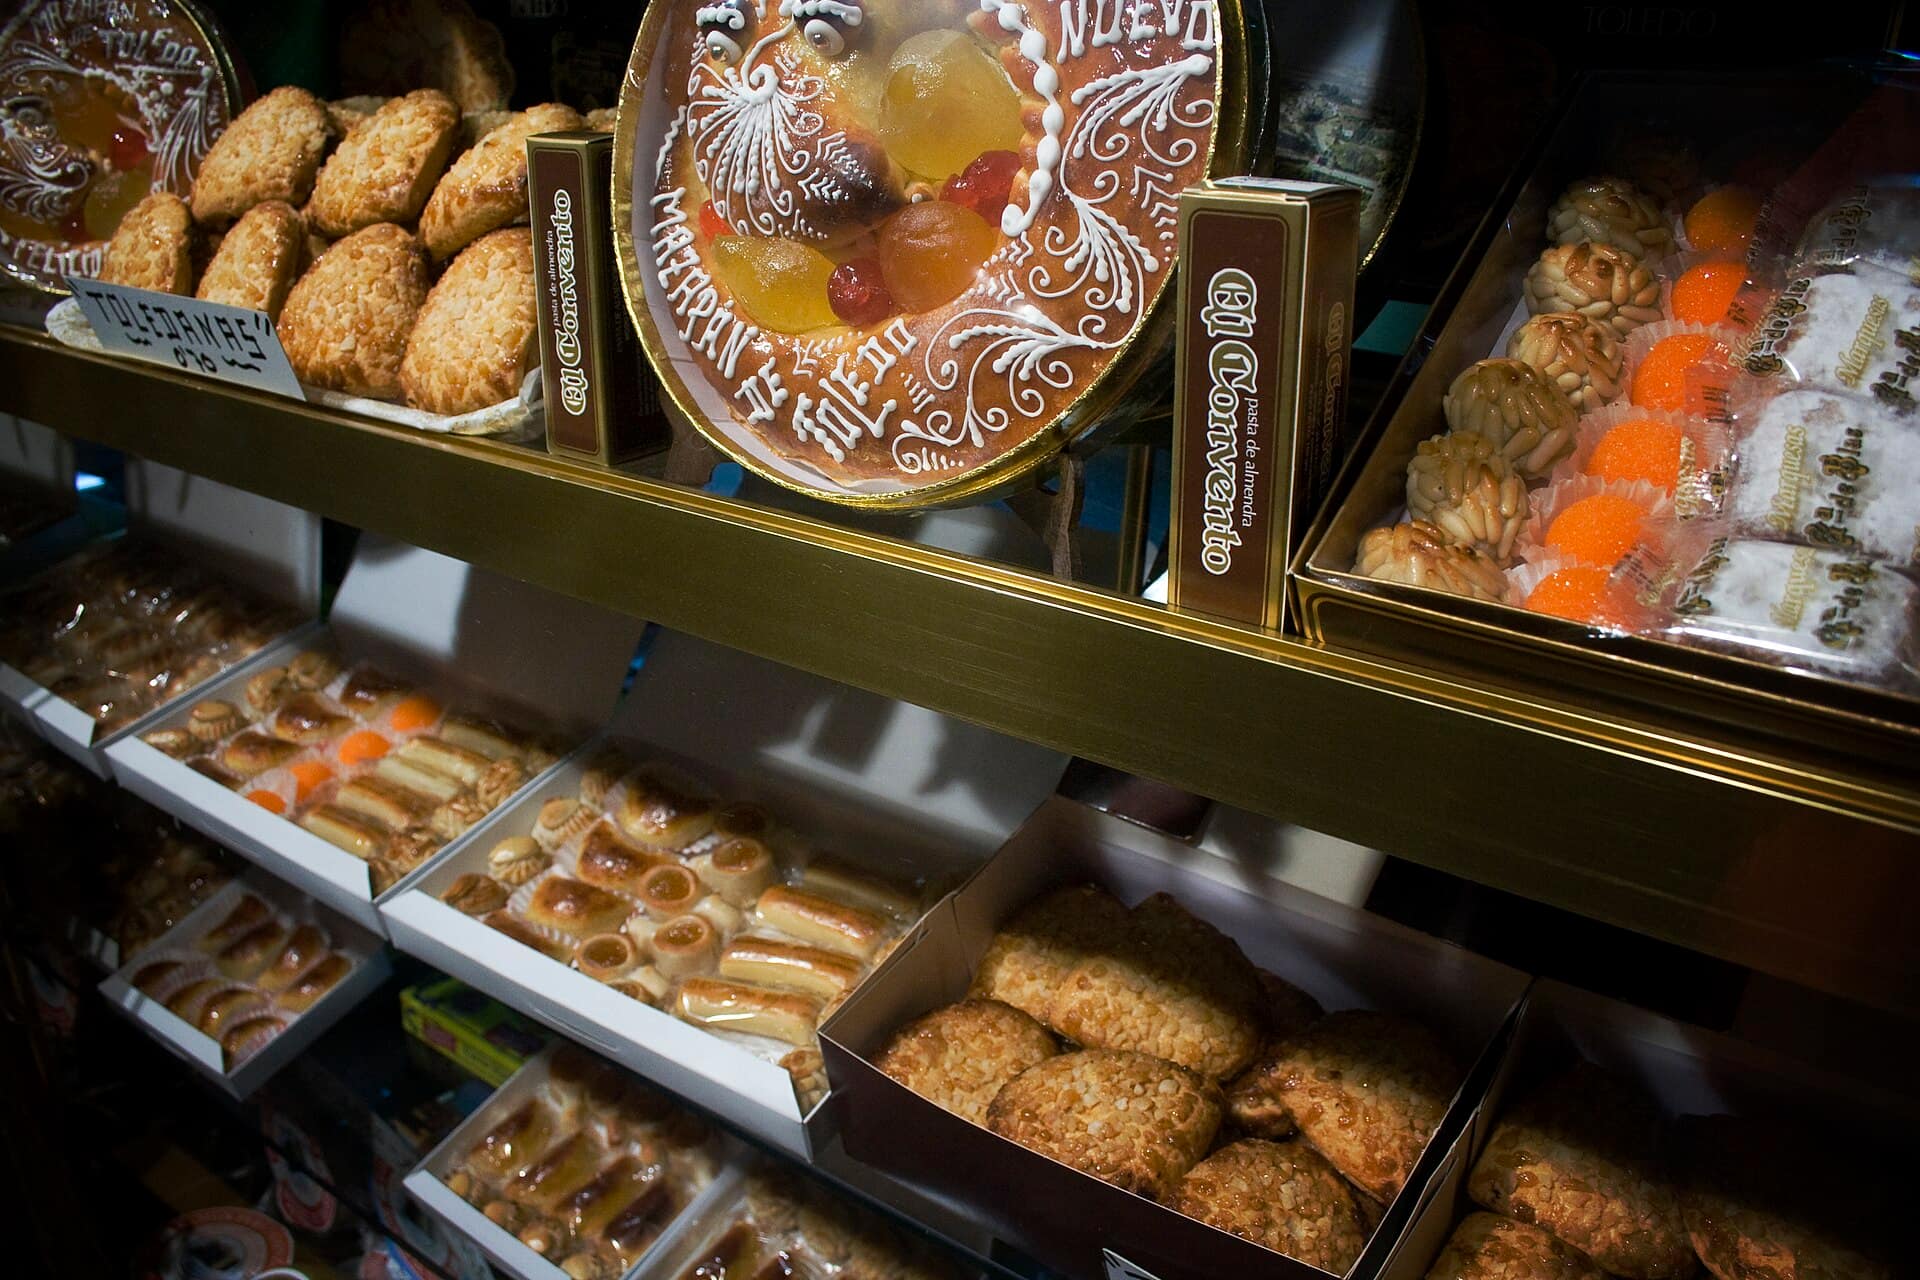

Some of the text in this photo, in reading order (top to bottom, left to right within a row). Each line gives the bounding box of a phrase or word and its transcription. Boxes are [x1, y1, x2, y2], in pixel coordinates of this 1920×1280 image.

[97, 27, 200, 67] TOLEDO
[1056, 0, 1215, 64] NUEVO
[1583, 5, 1718, 37] TOLEDO
[13, 239, 111, 279] FELICID
[545, 229, 562, 327] pasta de almendra
[551, 188, 589, 416] El Convento
[734, 356, 789, 424] DE
[791, 317, 919, 464] TOLEDO
[1836, 294, 1889, 390] Marquesas
[1201, 267, 1259, 576] El Convento
[1241, 396, 1259, 528] pasta de almendra
[1767, 424, 1815, 533] Marquesas
